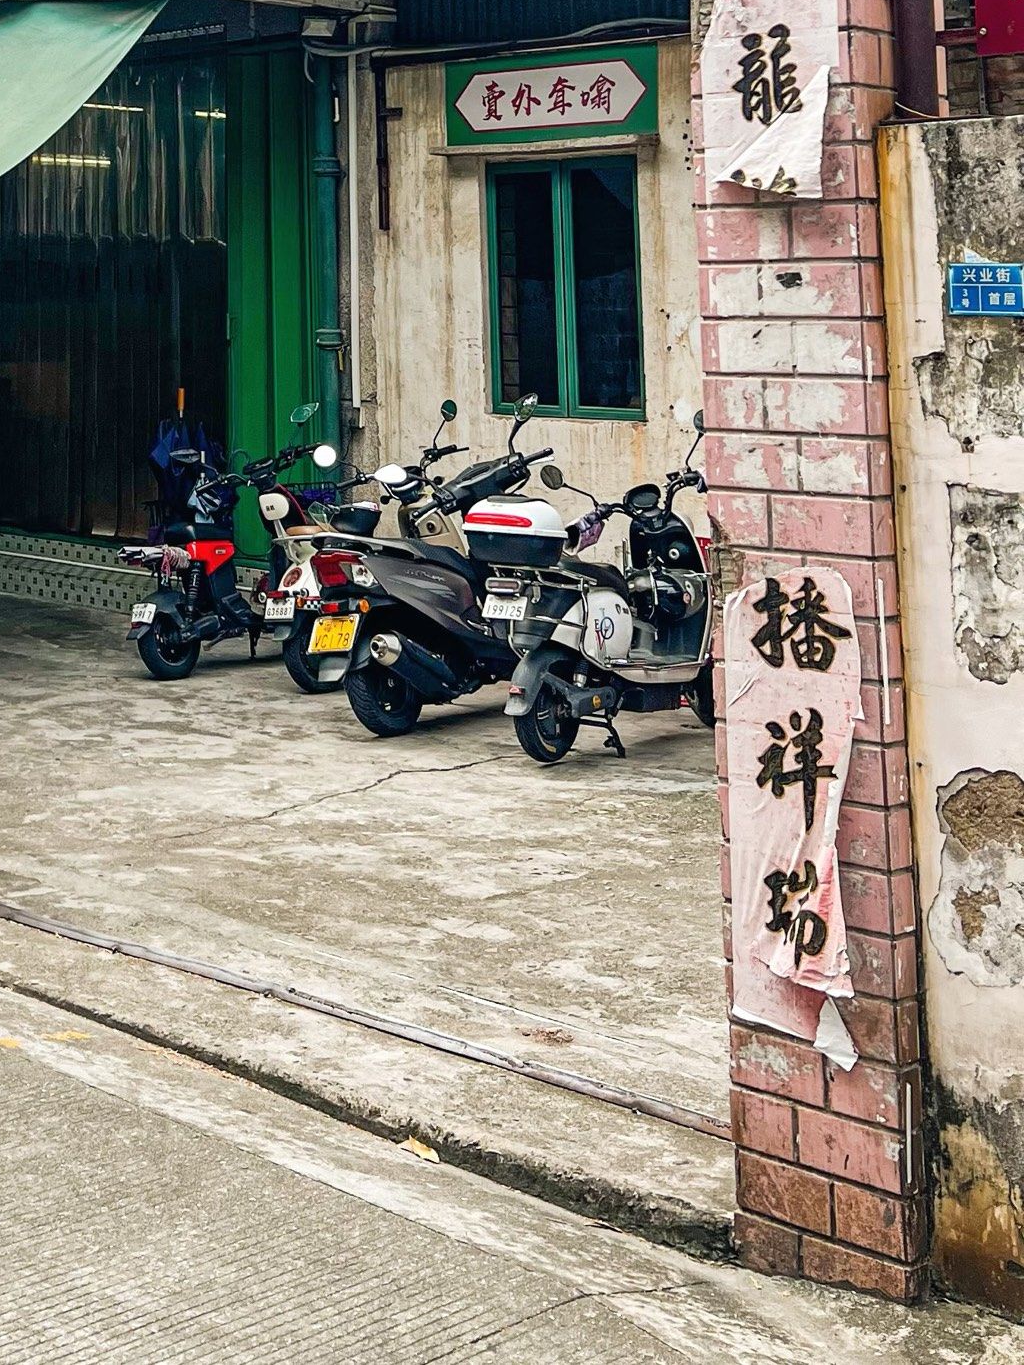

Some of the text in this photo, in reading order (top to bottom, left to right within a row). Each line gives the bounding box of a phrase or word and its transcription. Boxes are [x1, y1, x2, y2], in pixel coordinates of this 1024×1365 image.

[733, 23, 803, 125] 龍
[962, 267, 1011, 283] 兴业街
[961, 288, 970, 308] 3号
[988, 292, 1016, 306] 首层
